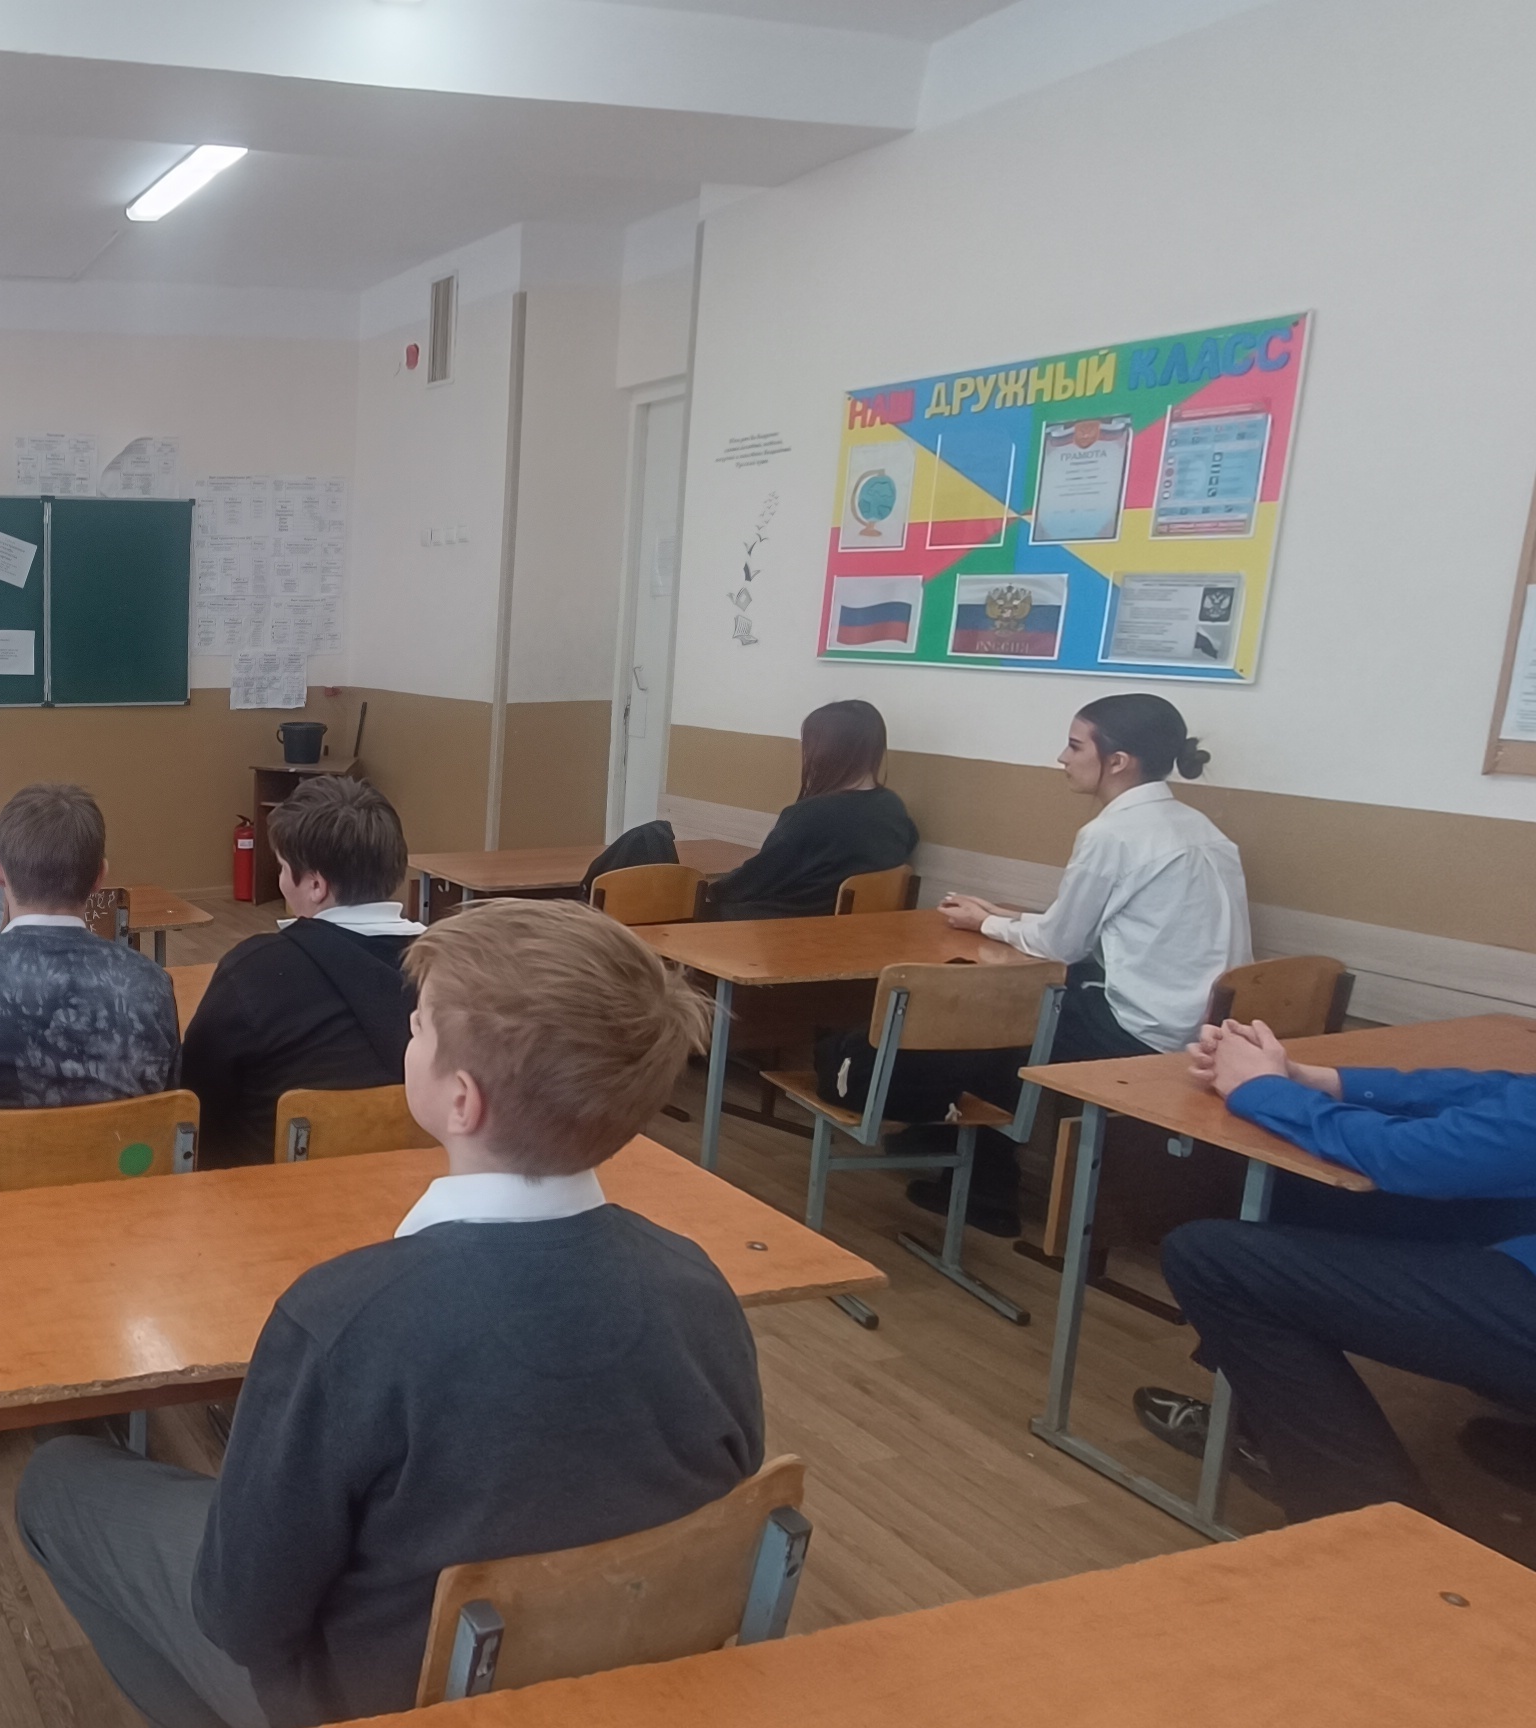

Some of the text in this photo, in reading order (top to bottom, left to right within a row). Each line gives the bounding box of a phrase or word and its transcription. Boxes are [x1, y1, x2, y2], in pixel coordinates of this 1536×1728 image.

[848, 326, 1292, 430] НАШ ДРУЖНЫЙ КЛАСС
[1059, 449, 1108, 462] ГРАМОТА
